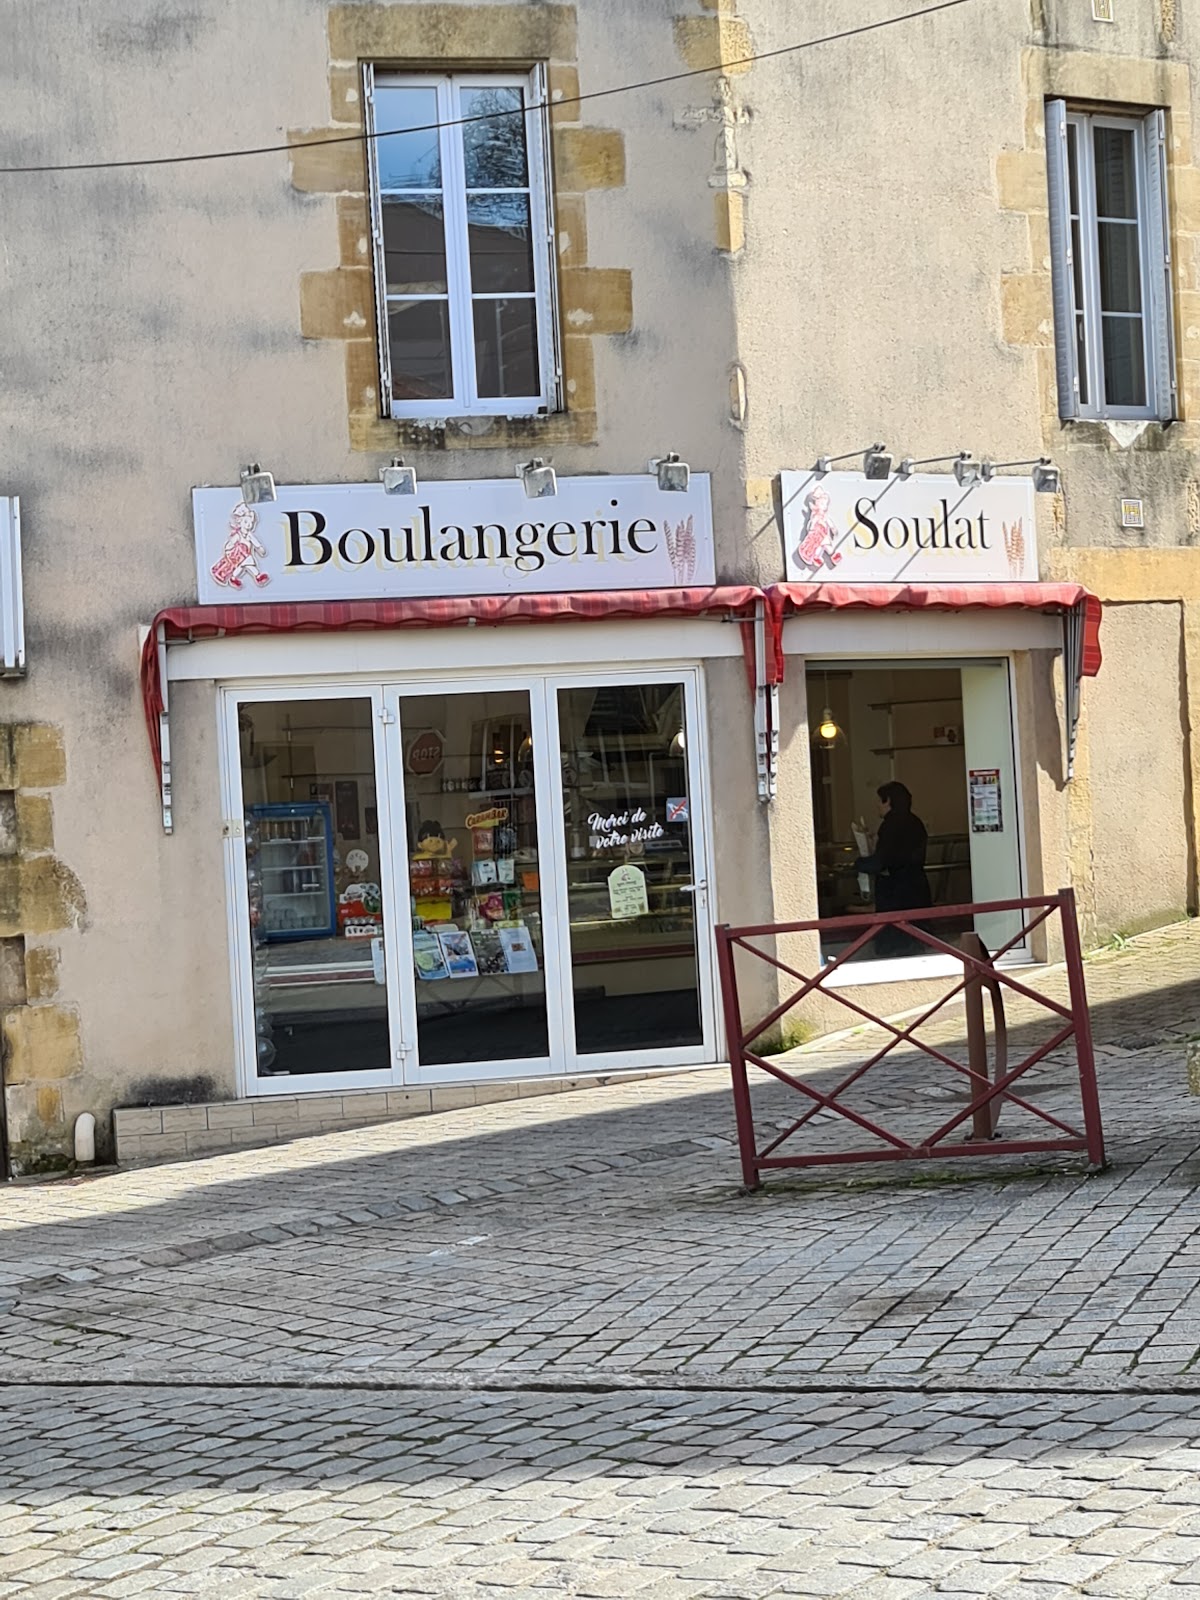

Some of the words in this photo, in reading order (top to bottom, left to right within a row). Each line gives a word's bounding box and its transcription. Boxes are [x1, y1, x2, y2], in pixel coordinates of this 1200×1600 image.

[281, 499, 658, 571] Boulangerie
[853, 496, 993, 550] Soulat
[588, 812, 629, 832] Merci
[631, 807, 647, 822] de
[631, 822, 664, 842] visite
